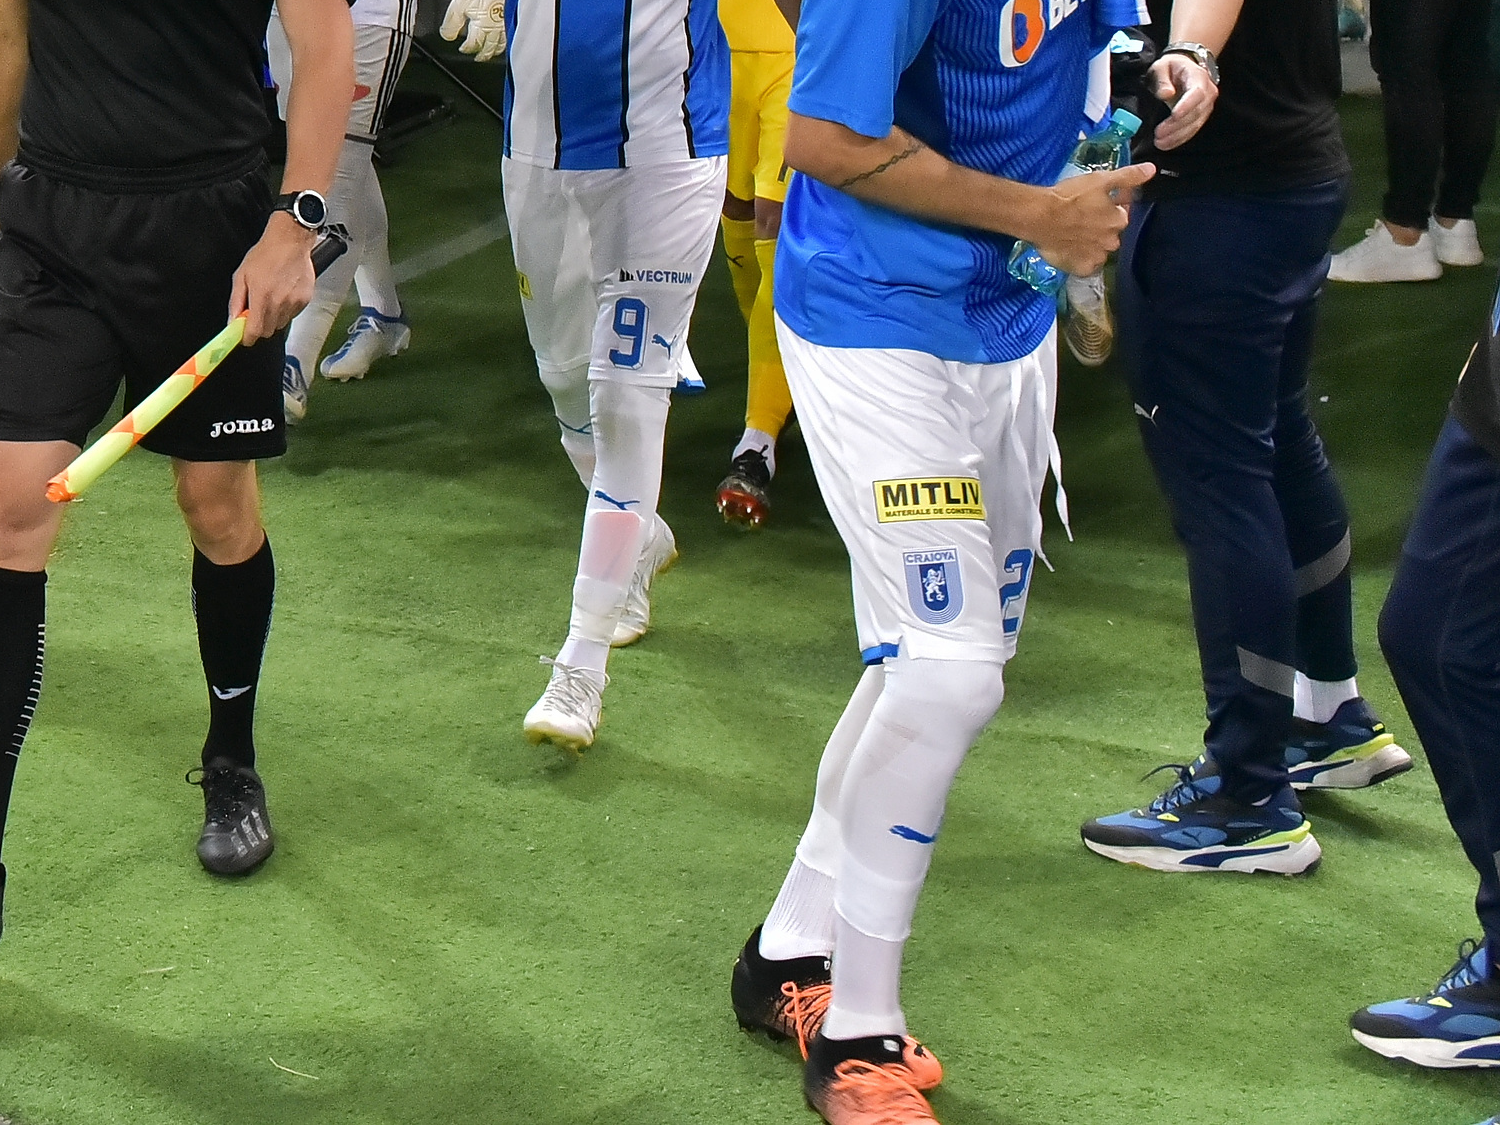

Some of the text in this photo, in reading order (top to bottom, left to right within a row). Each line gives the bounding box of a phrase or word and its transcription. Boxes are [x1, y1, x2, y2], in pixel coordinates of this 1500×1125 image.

[634, 269, 693, 284] VECTRUM
[608, 296, 650, 371] 9
[885, 509, 931, 517] MATERIALE
[933, 507, 943, 515] DE
